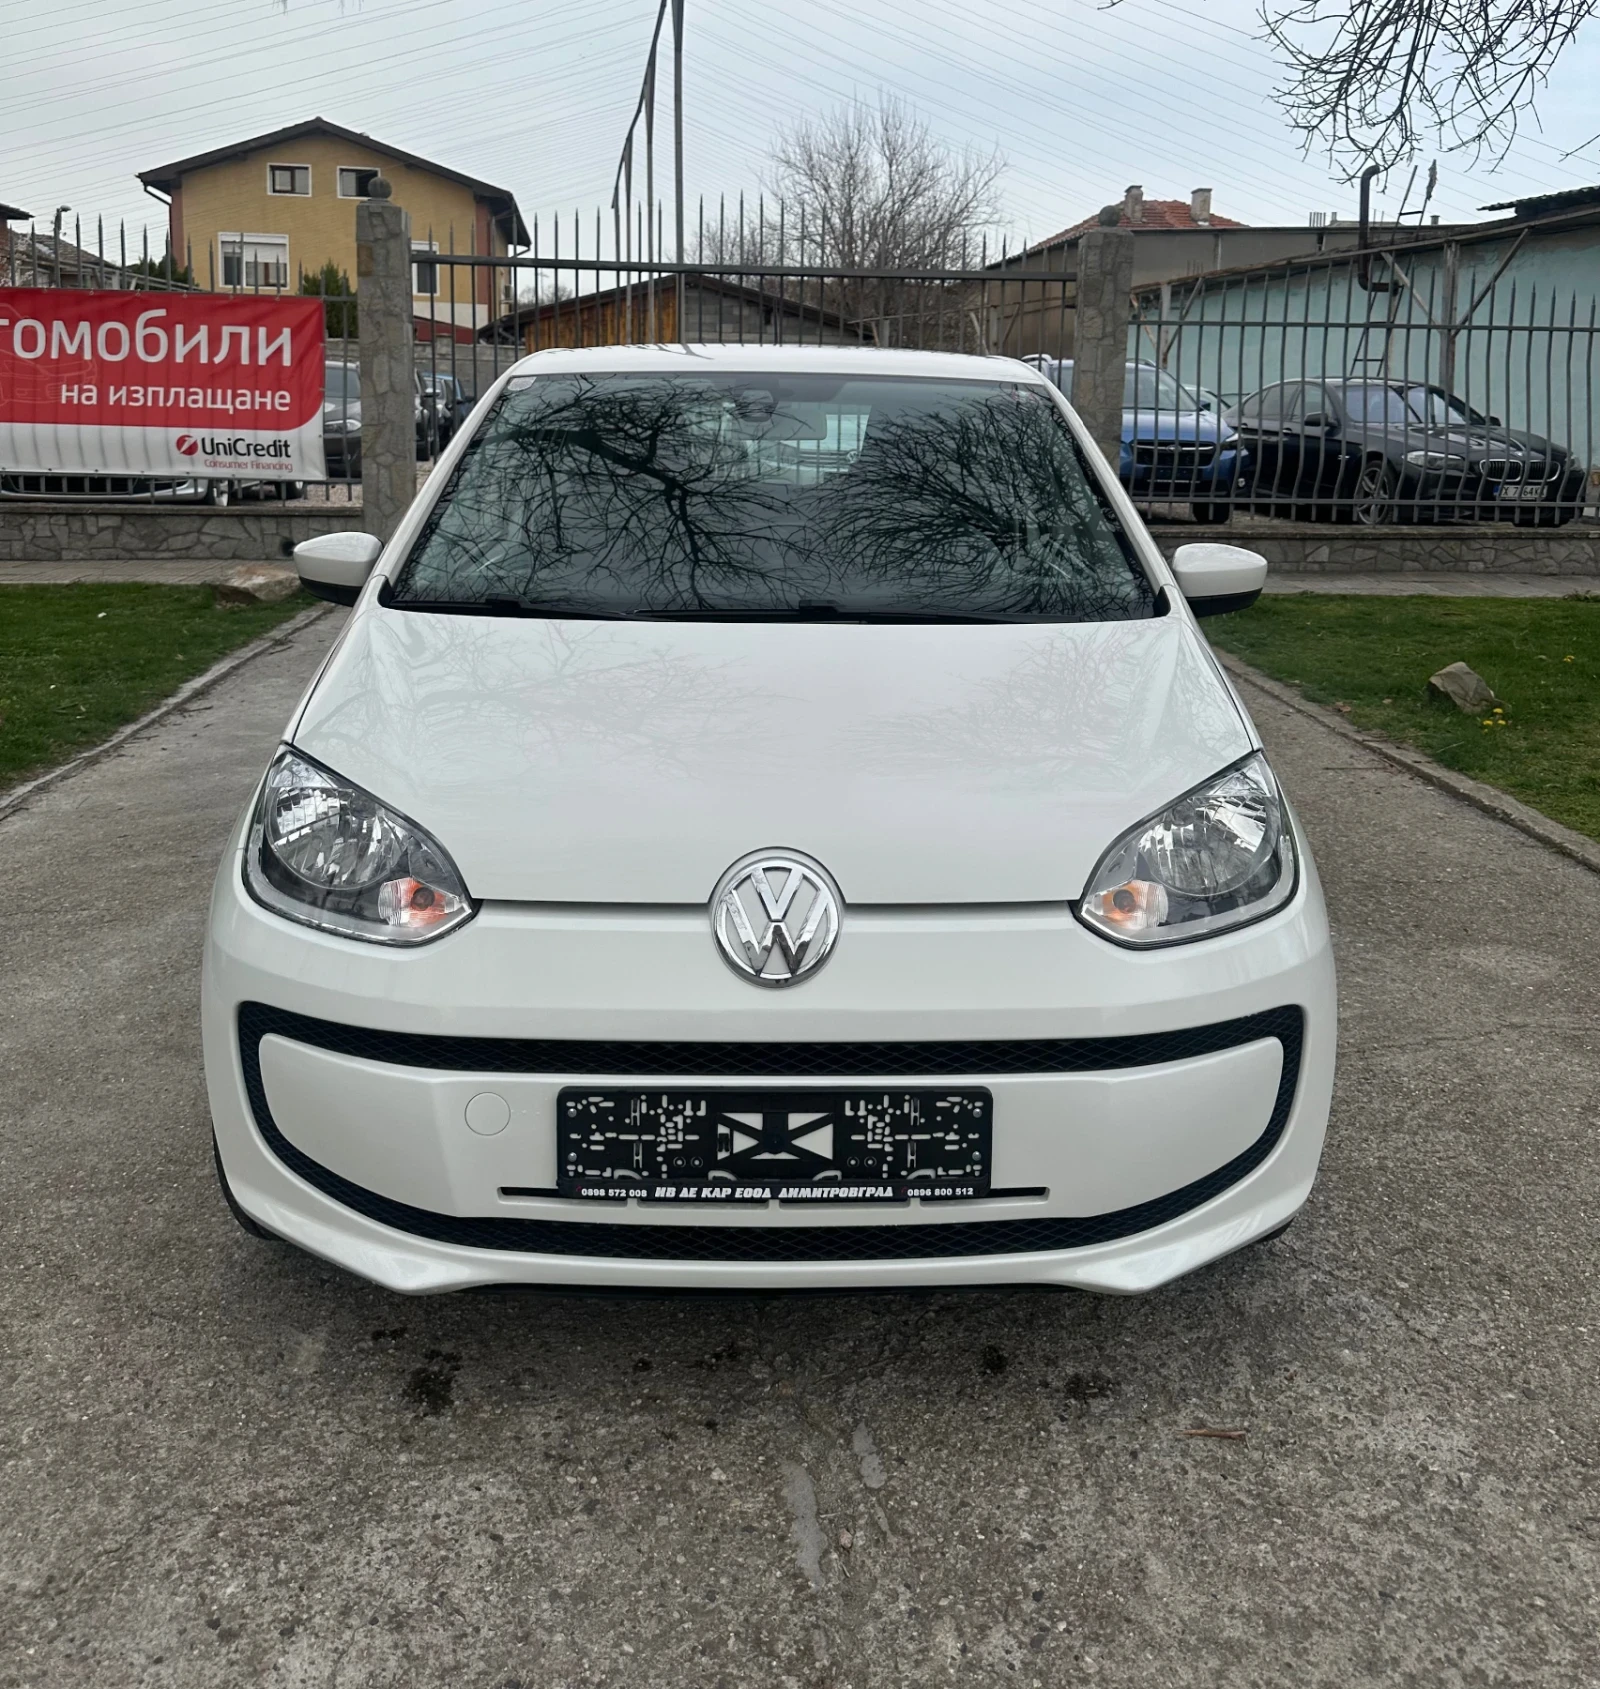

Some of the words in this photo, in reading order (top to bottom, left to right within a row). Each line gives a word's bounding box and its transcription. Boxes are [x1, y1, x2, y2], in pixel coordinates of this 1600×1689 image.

[61, 384, 98, 405] на
[109, 386, 291, 414] изплащане
[201, 437, 291, 458] UniCredit
[204, 459, 249, 469] Consumer
[251, 461, 293, 473] Financing
[581, 1188, 606, 1197] 0898
[608, 1188, 627, 1197] 572
[629, 1188, 648, 1197] 008
[701, 1187, 732, 1198] КАР
[735, 1187, 772, 1198] ЕООД
[778, 1187, 894, 1198] ДИМИТРОВГРАД
[907, 1187, 932, 1197] 0896
[934, 1187, 953, 1197] 800
[955, 1187, 974, 1197] 512
